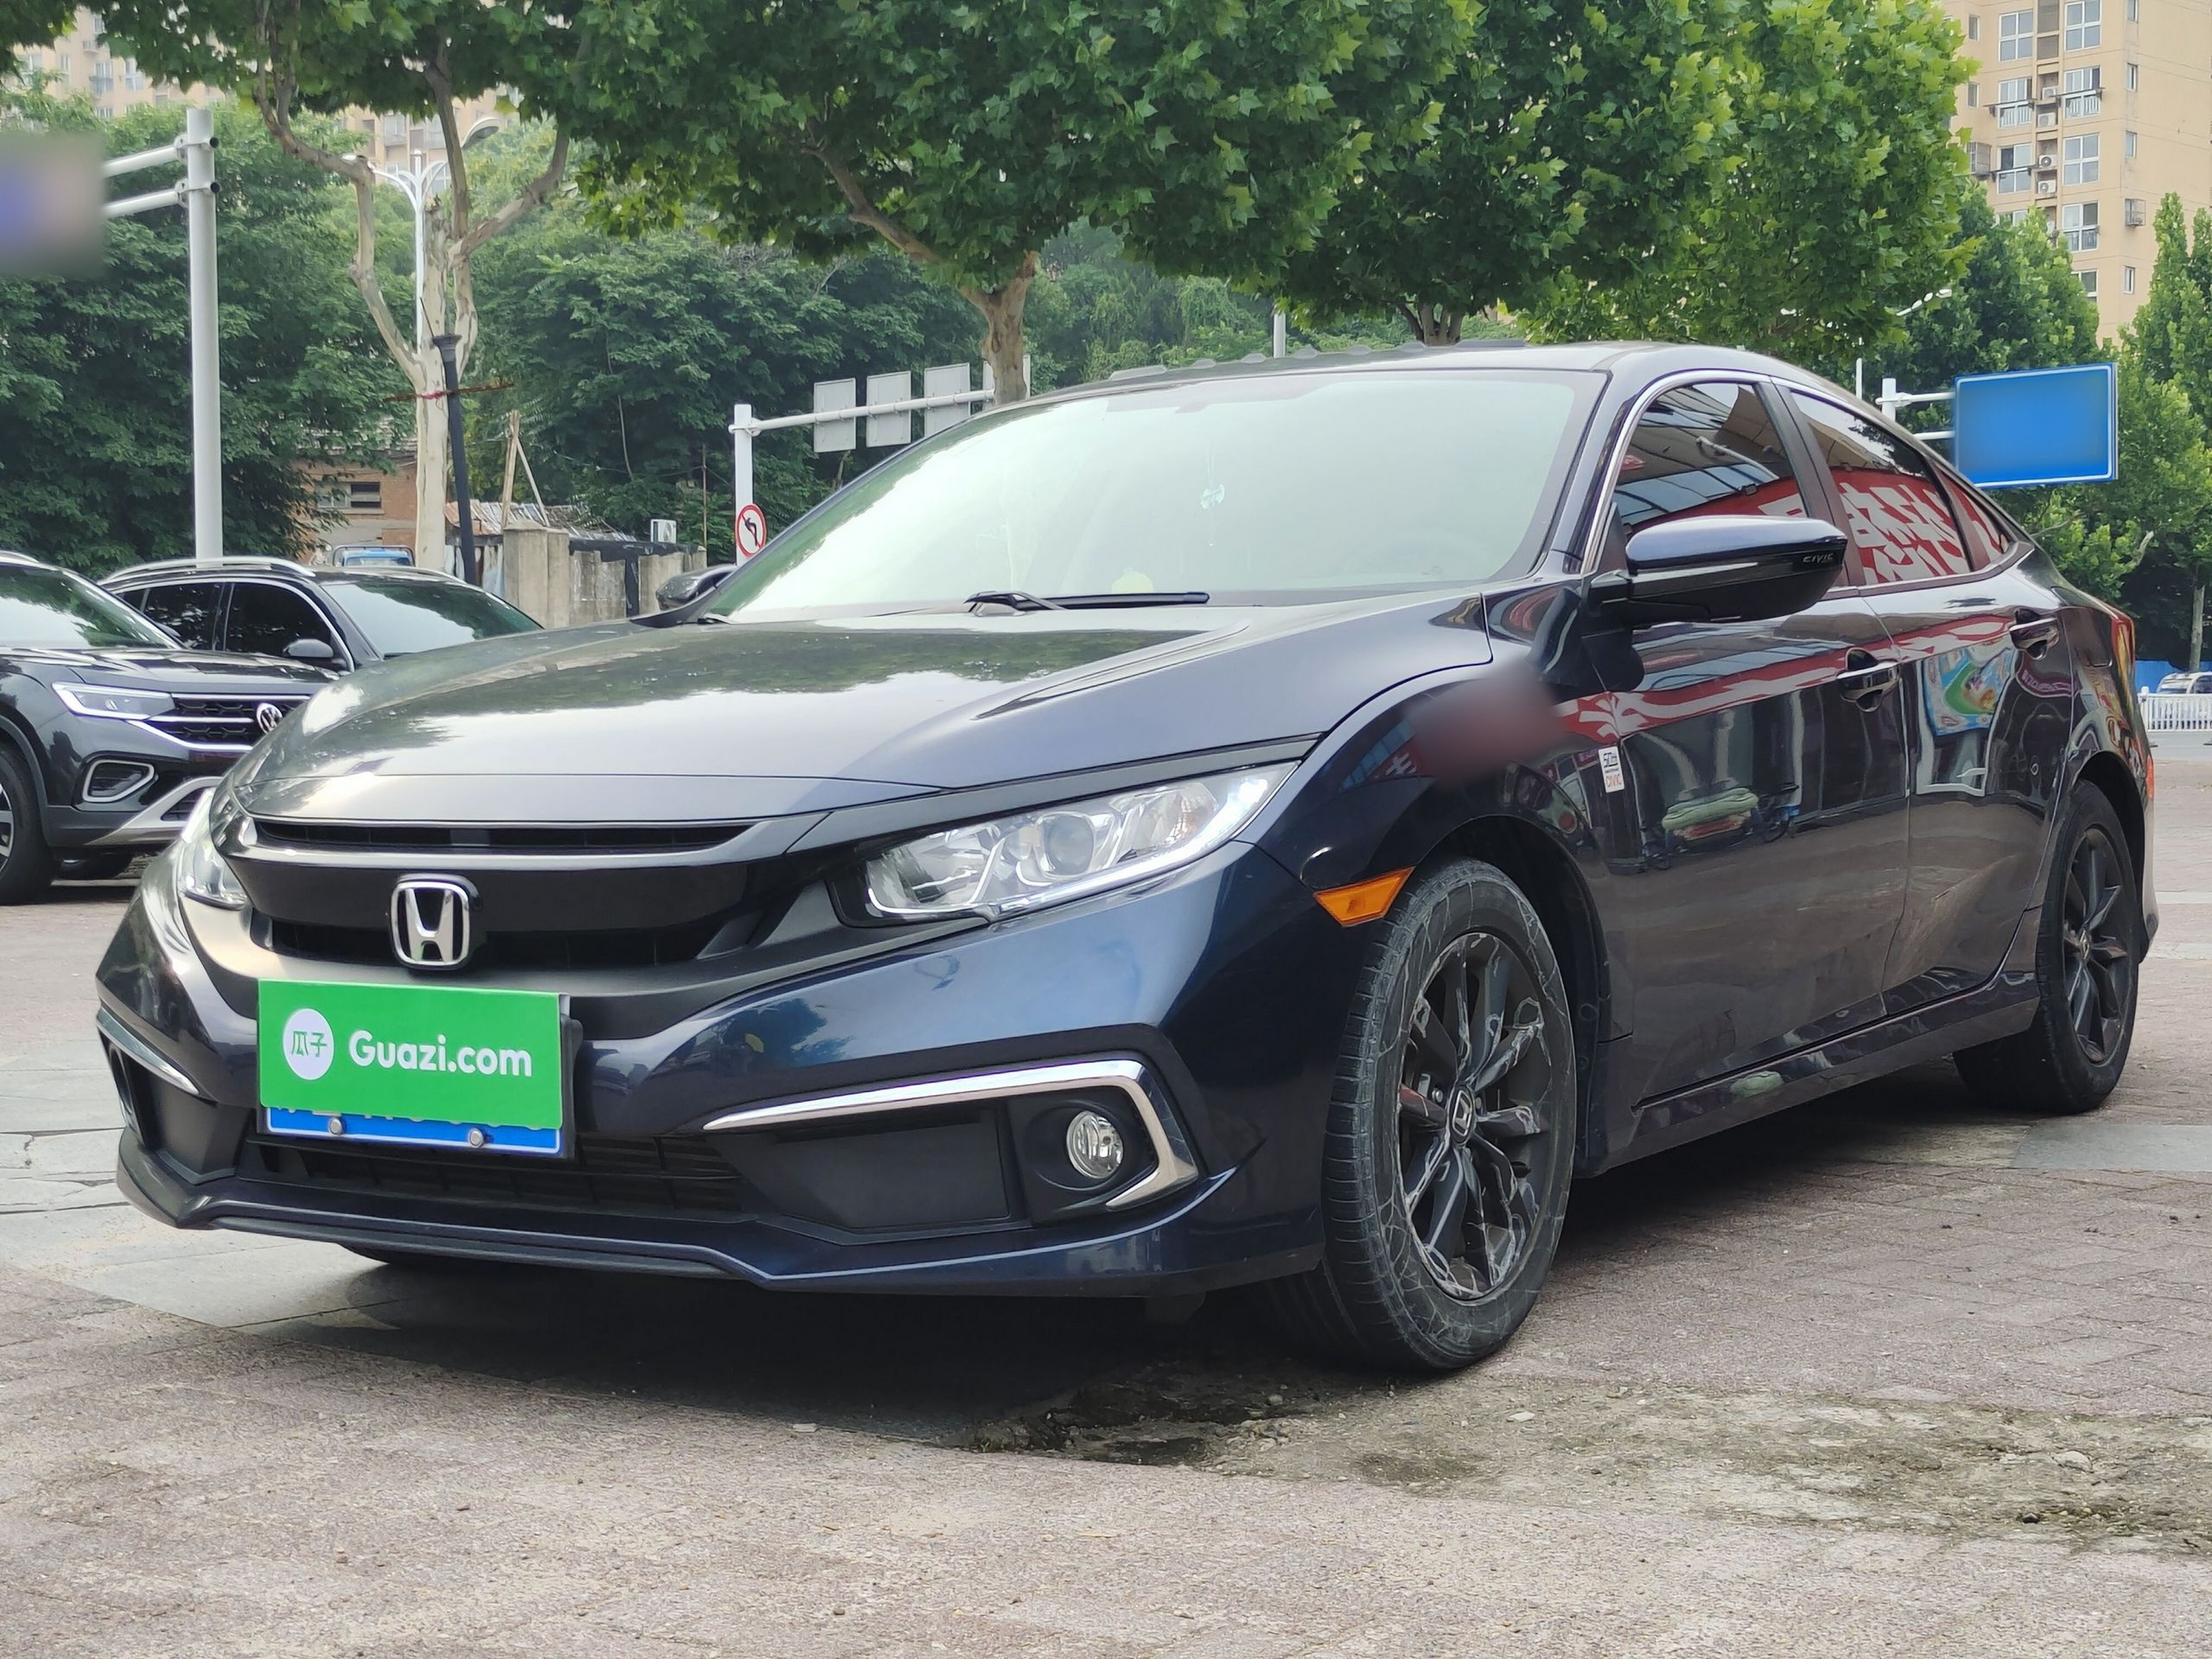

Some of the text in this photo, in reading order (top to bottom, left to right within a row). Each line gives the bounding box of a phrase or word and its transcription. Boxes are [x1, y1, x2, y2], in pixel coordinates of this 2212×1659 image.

[1802, 552, 1834, 564] CIVIC
[291, 1031, 327, 1058] 瓜子
[349, 1029, 532, 1077] Guazi.com
